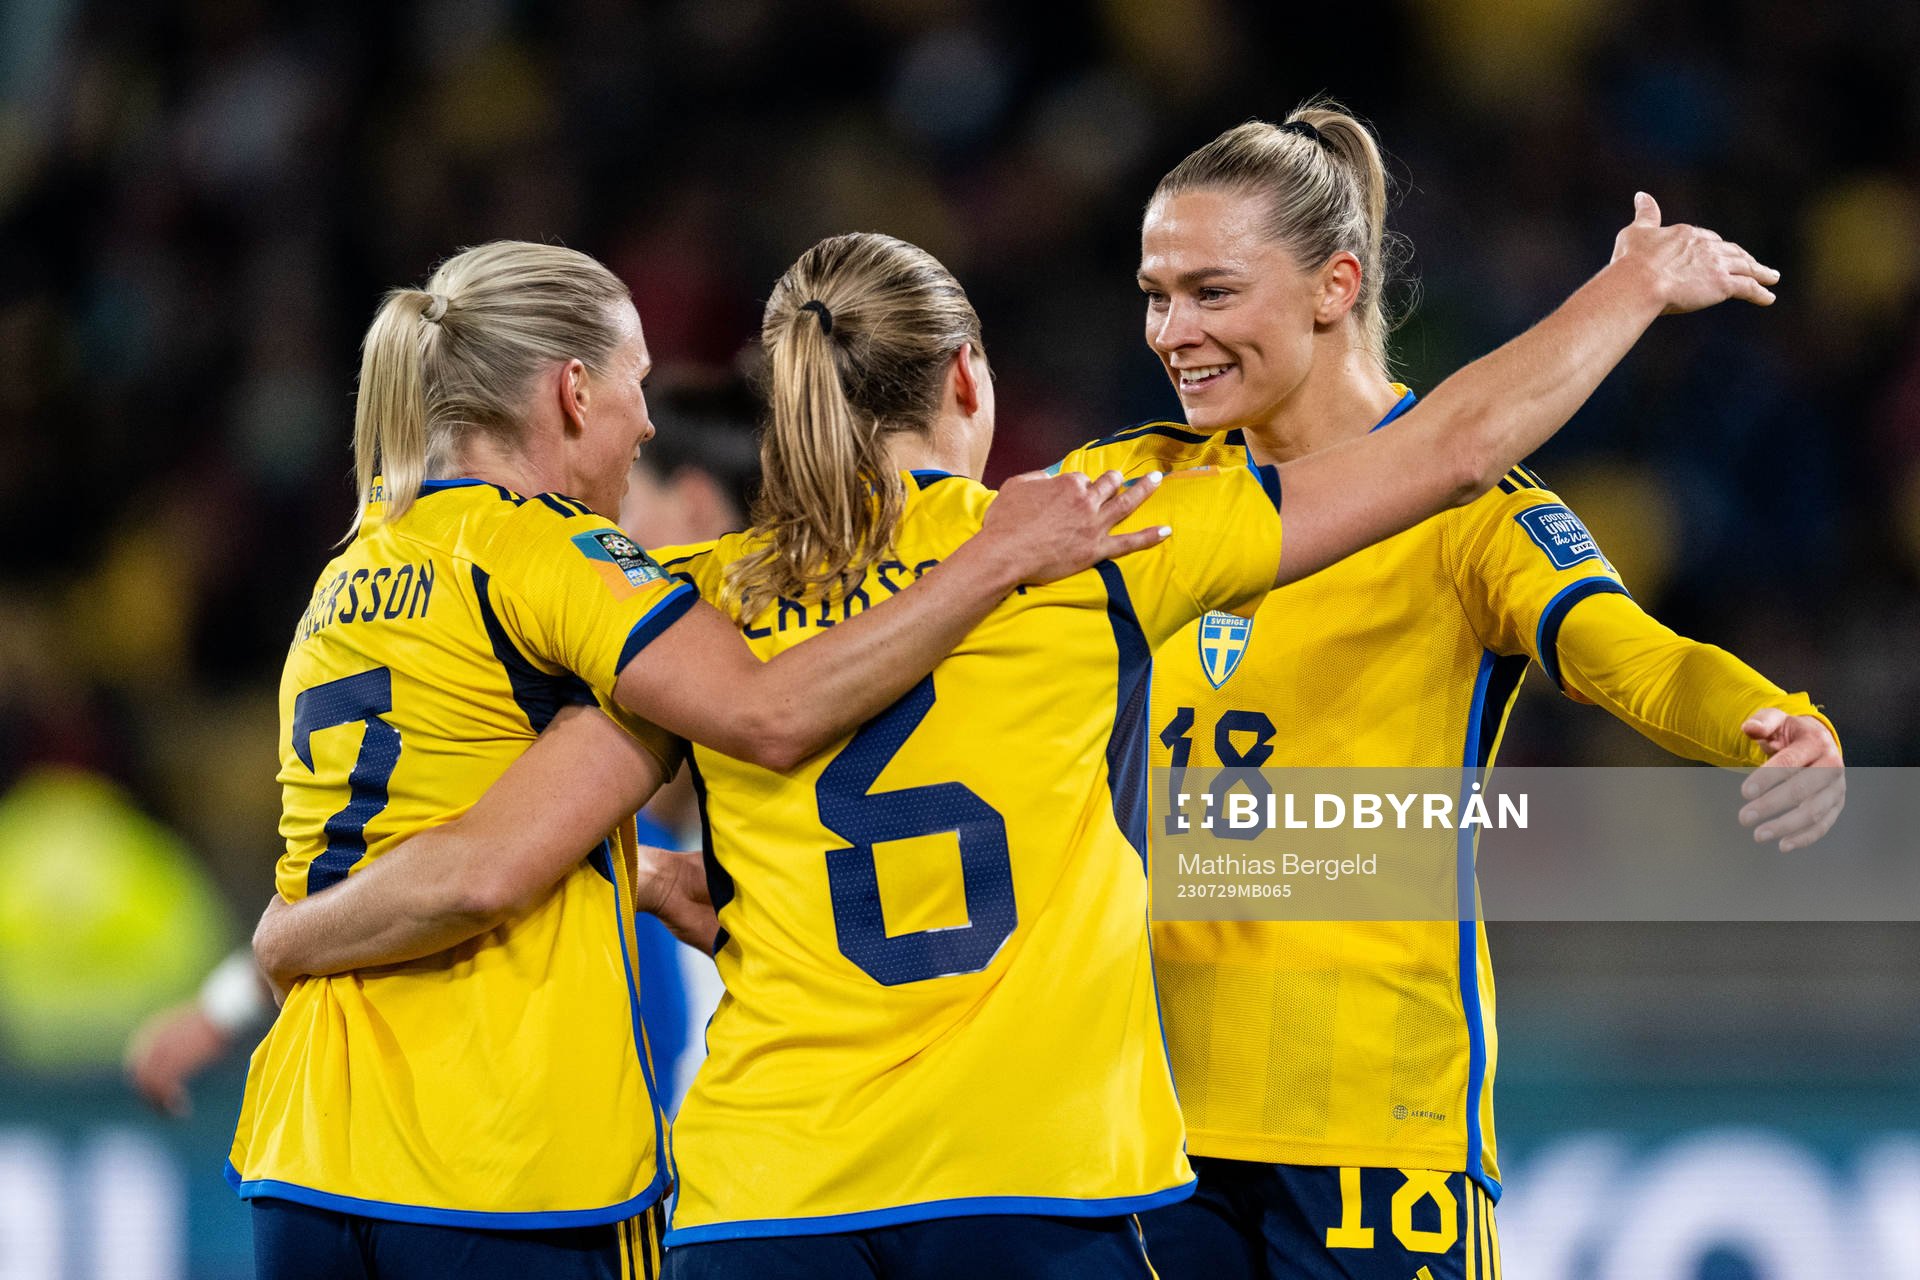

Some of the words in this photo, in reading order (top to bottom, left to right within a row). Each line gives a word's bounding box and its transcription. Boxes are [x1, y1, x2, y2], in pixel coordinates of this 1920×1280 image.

[1545, 519, 1584, 535] UNITE
[1552, 533, 1570, 546] the
[1211, 617, 1245, 626] SVERIGE
[292, 666, 402, 896] 7
[1159, 707, 1277, 841] 18
[815, 672, 1019, 985] 6
[1325, 1167, 1458, 1255] 18
